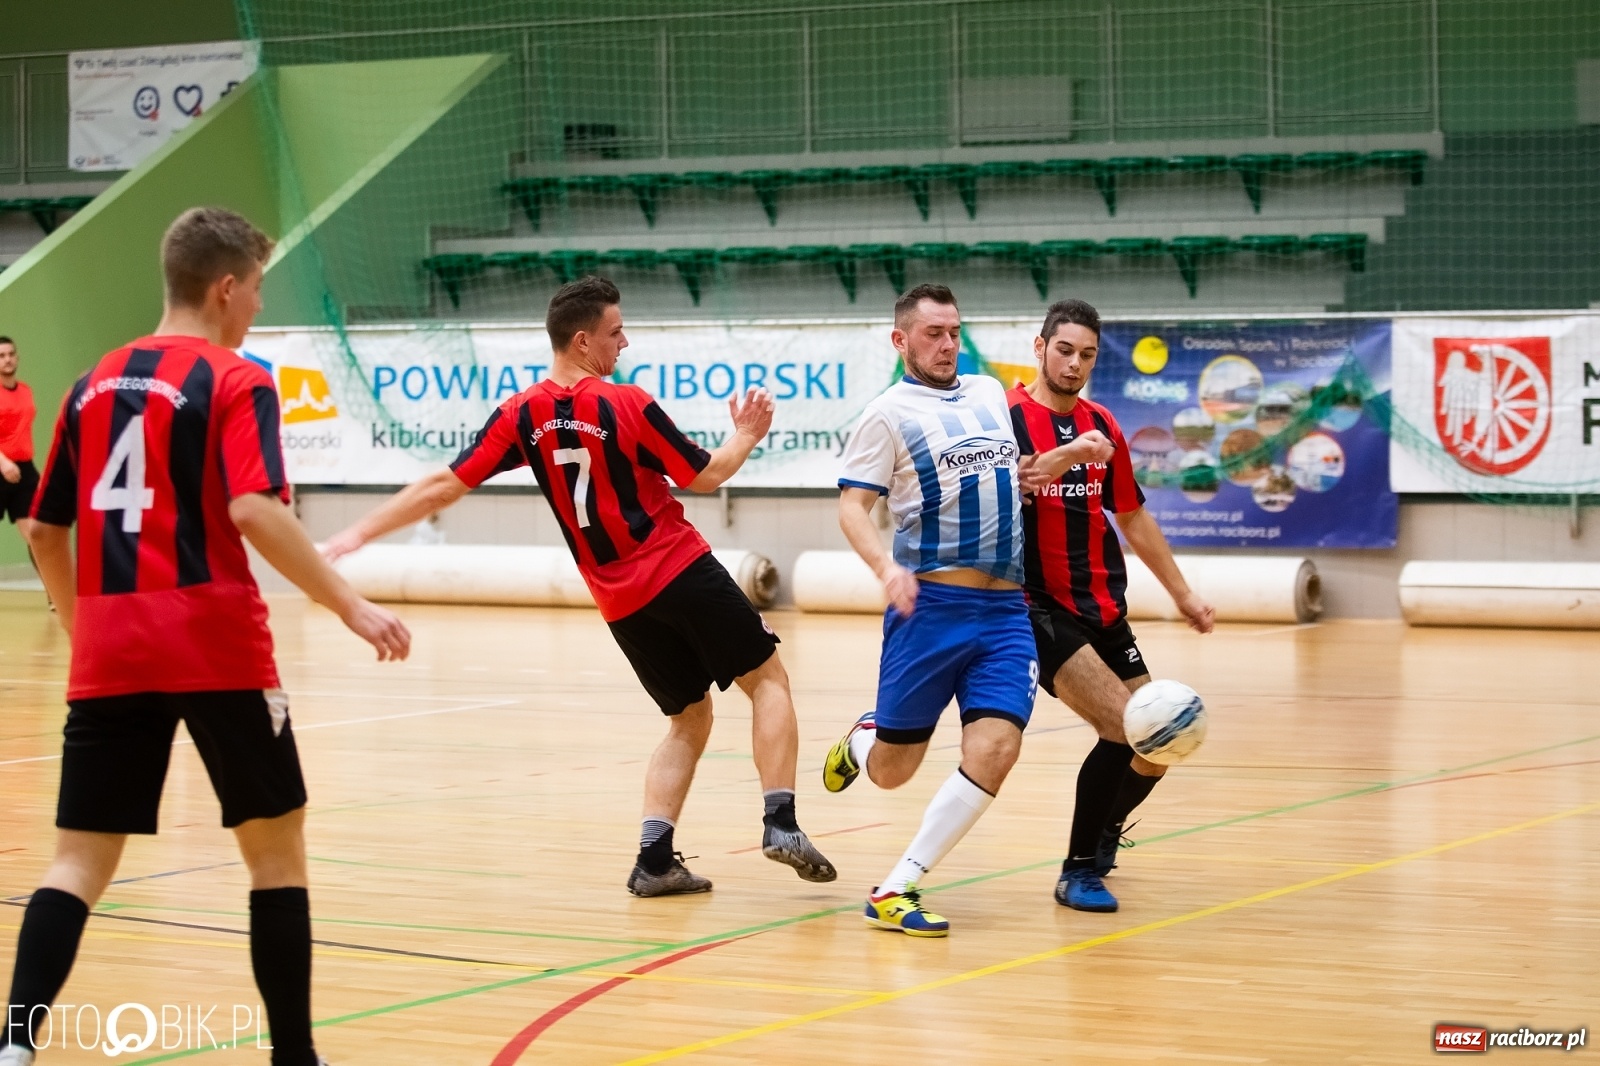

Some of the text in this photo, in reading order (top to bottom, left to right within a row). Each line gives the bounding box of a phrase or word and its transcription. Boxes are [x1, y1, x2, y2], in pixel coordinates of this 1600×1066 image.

[96, 376, 188, 410] GRZEGORZOWICE
[373, 362, 846, 400] POWIAT CIBORSKI
[371, 422, 480, 452] kibicuje
[530, 418, 609, 446] LKS RZEORZOWICE
[945, 445, 1015, 468] Kosmo-Car
[90, 415, 155, 533] 4
[553, 447, 592, 528] 7
[1033, 478, 1103, 498] Warzech
[1028, 659, 1039, 690] 9
